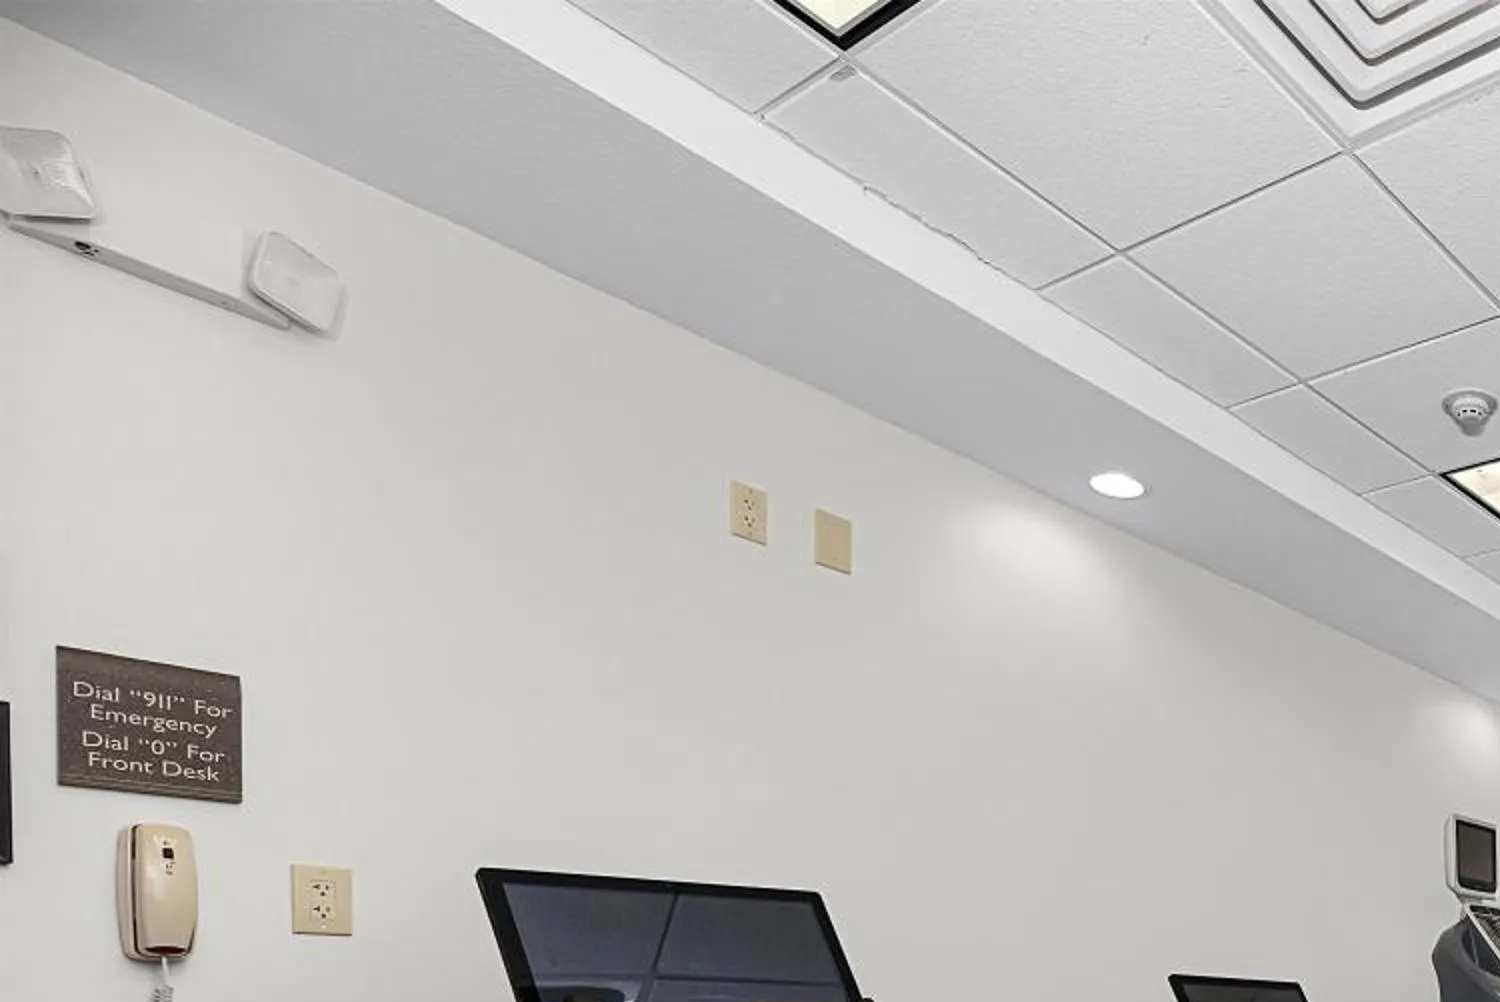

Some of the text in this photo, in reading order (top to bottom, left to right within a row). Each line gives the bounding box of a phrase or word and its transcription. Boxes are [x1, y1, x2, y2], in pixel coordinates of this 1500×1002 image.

[73, 681, 232, 718] Dial "911" For
[91, 703, 218, 739] Emergency
[82, 730, 129, 751] Dial
[187, 743, 225, 763] For
[88, 751, 221, 782] Front Desk
